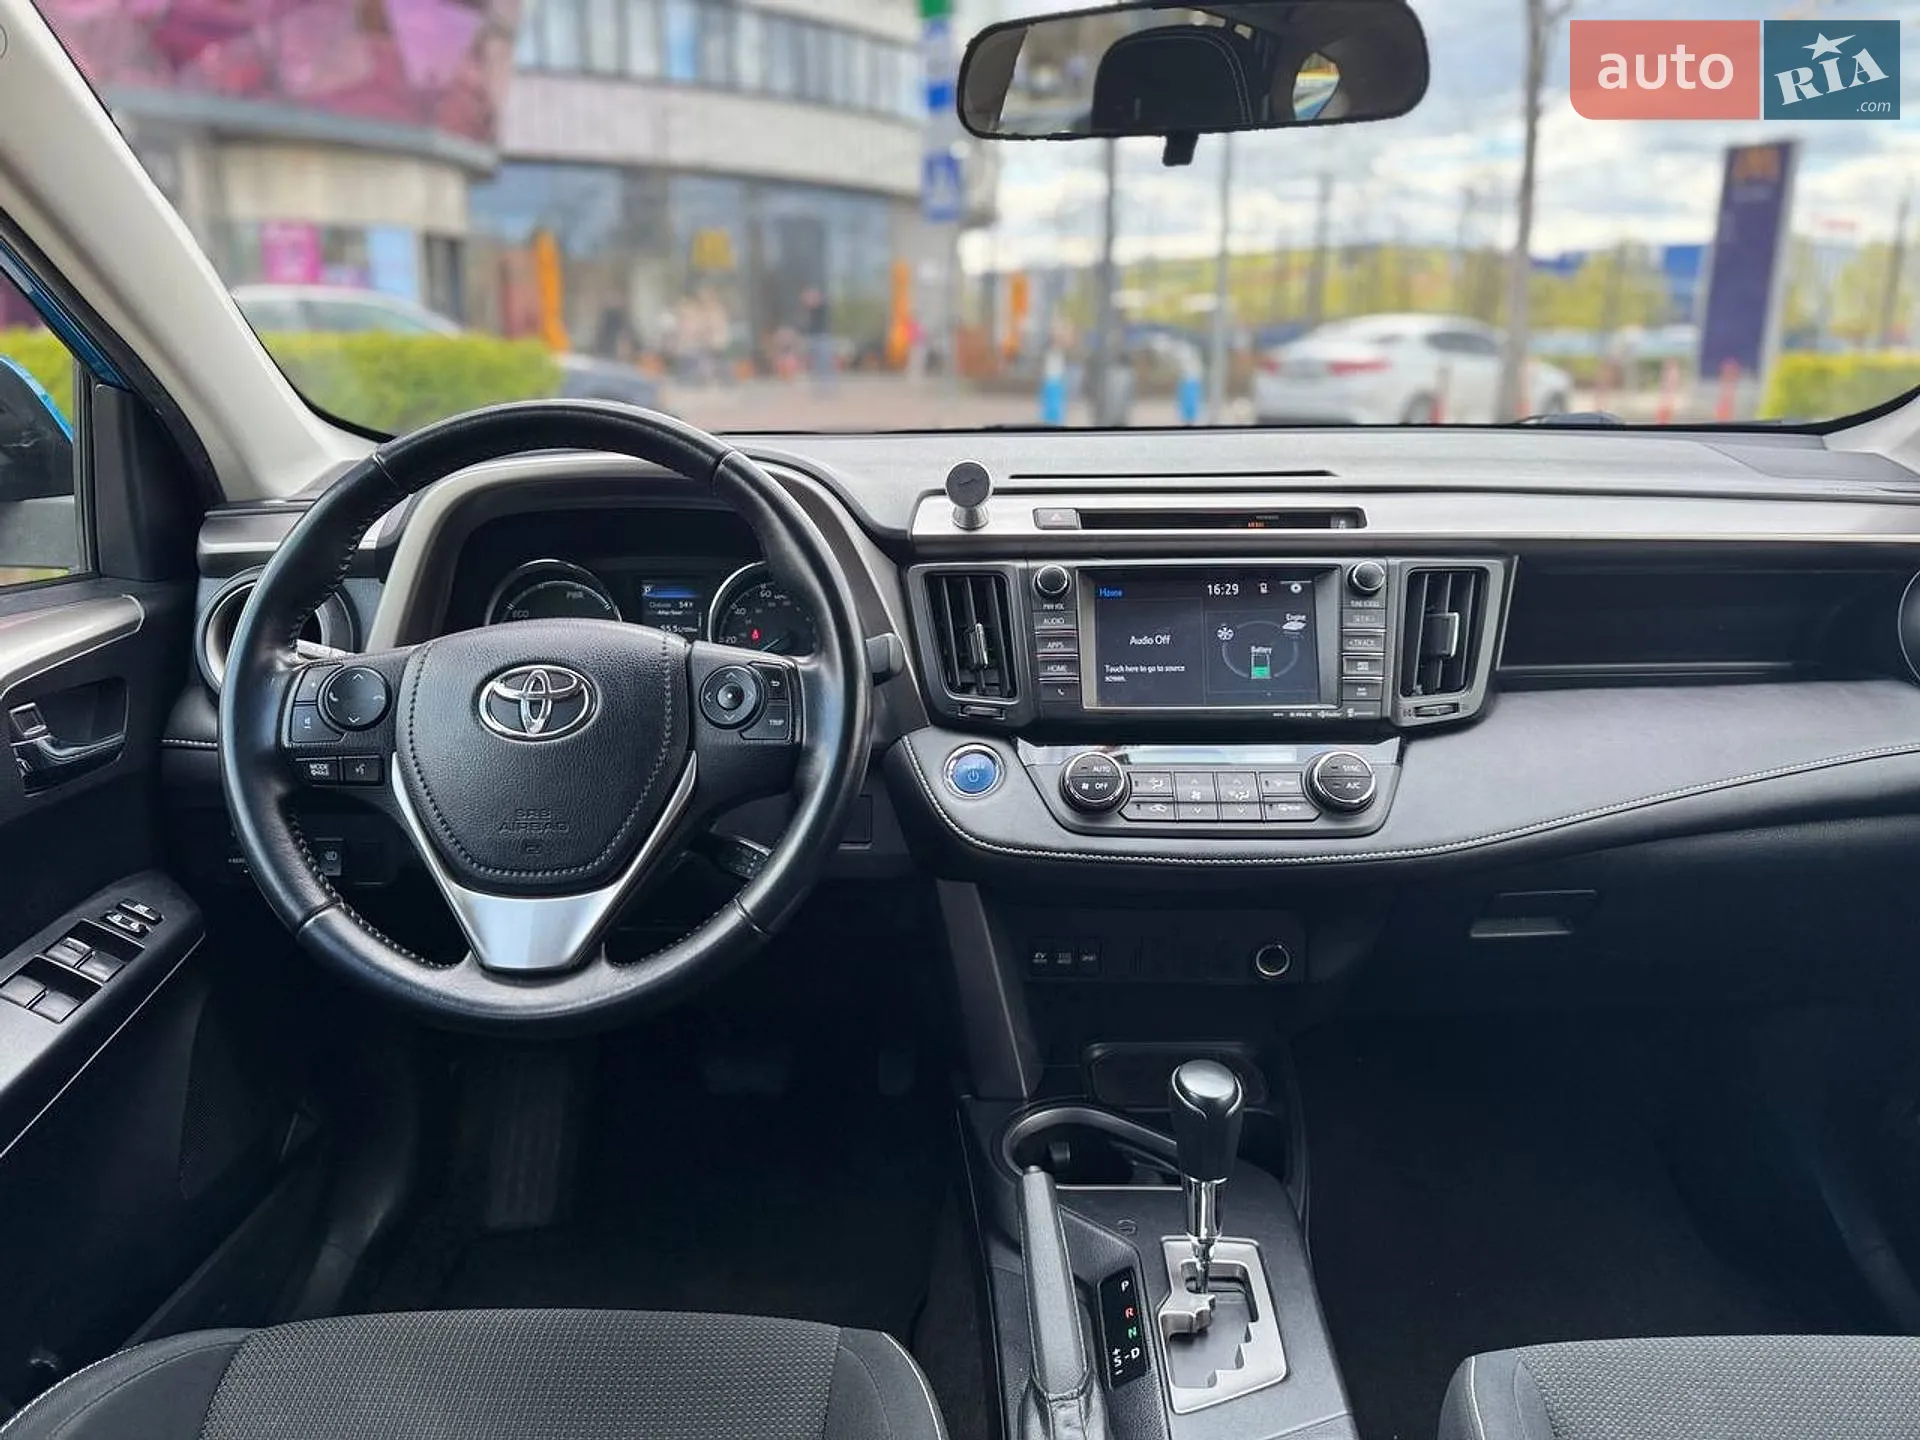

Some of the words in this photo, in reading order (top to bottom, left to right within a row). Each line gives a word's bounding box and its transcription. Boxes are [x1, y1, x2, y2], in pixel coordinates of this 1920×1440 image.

[1099, 588, 1123, 597] Home
[1207, 583, 1239, 596] 16:29
[1043, 617, 1065, 625] AUDIO
[1046, 641, 1064, 649] APPS
[1129, 635, 1154, 645] Audio
[1155, 634, 1171, 645] Off
[1104, 664, 1125, 673] Touch
[1125, 664, 1139, 673] here
[1140, 664, 1147, 672] to
[1148, 666, 1156, 674] go
[1095, 782, 1108, 790] OFF
[516, 809, 552, 819] SRS
[499, 822, 569, 833] AIRBAG
[1121, 1280, 1129, 1292] P
[1125, 1307, 1134, 1318] R
[1128, 1326, 1137, 1338] N
[1130, 1347, 1140, 1360] D
